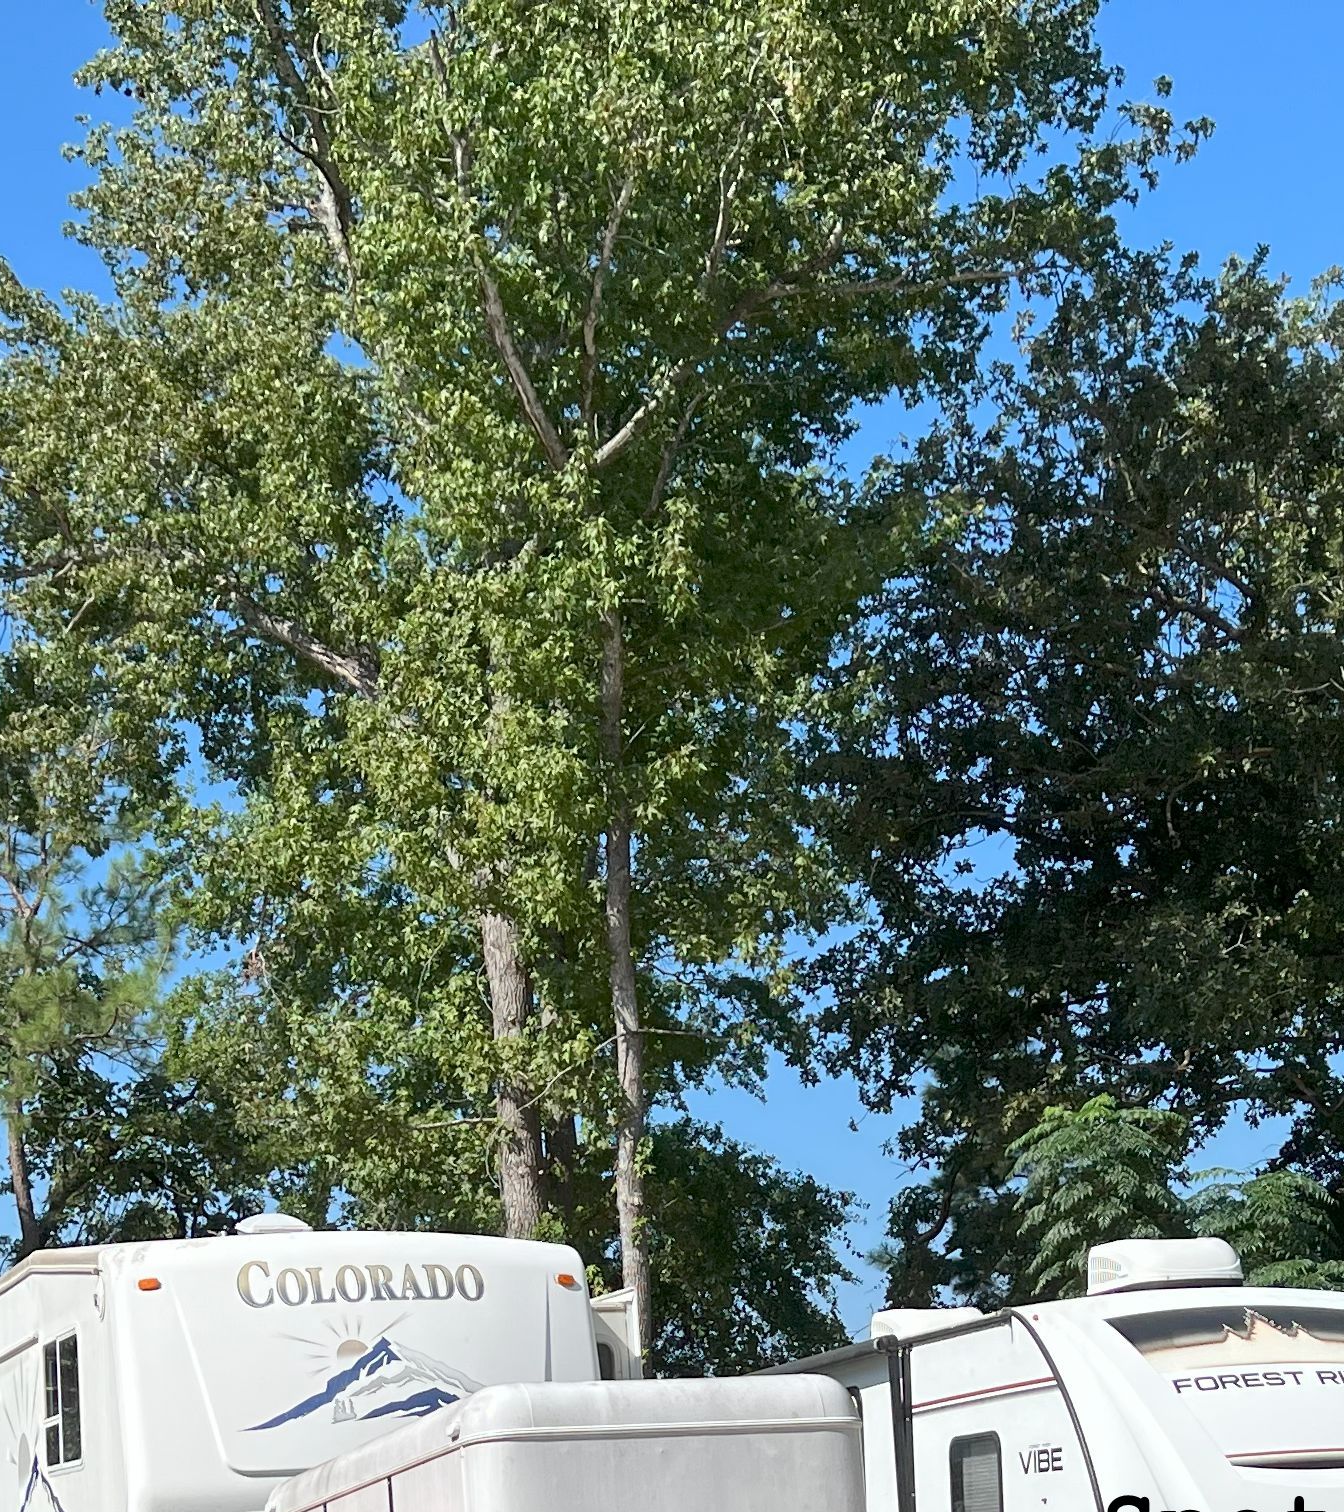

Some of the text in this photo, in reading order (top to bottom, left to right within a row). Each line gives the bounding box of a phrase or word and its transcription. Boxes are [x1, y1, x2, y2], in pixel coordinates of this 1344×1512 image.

[236, 1260, 485, 1309] COLORADO
[1171, 1370, 1304, 1394] FOREST
[1018, 1447, 1064, 1475] VIBE
